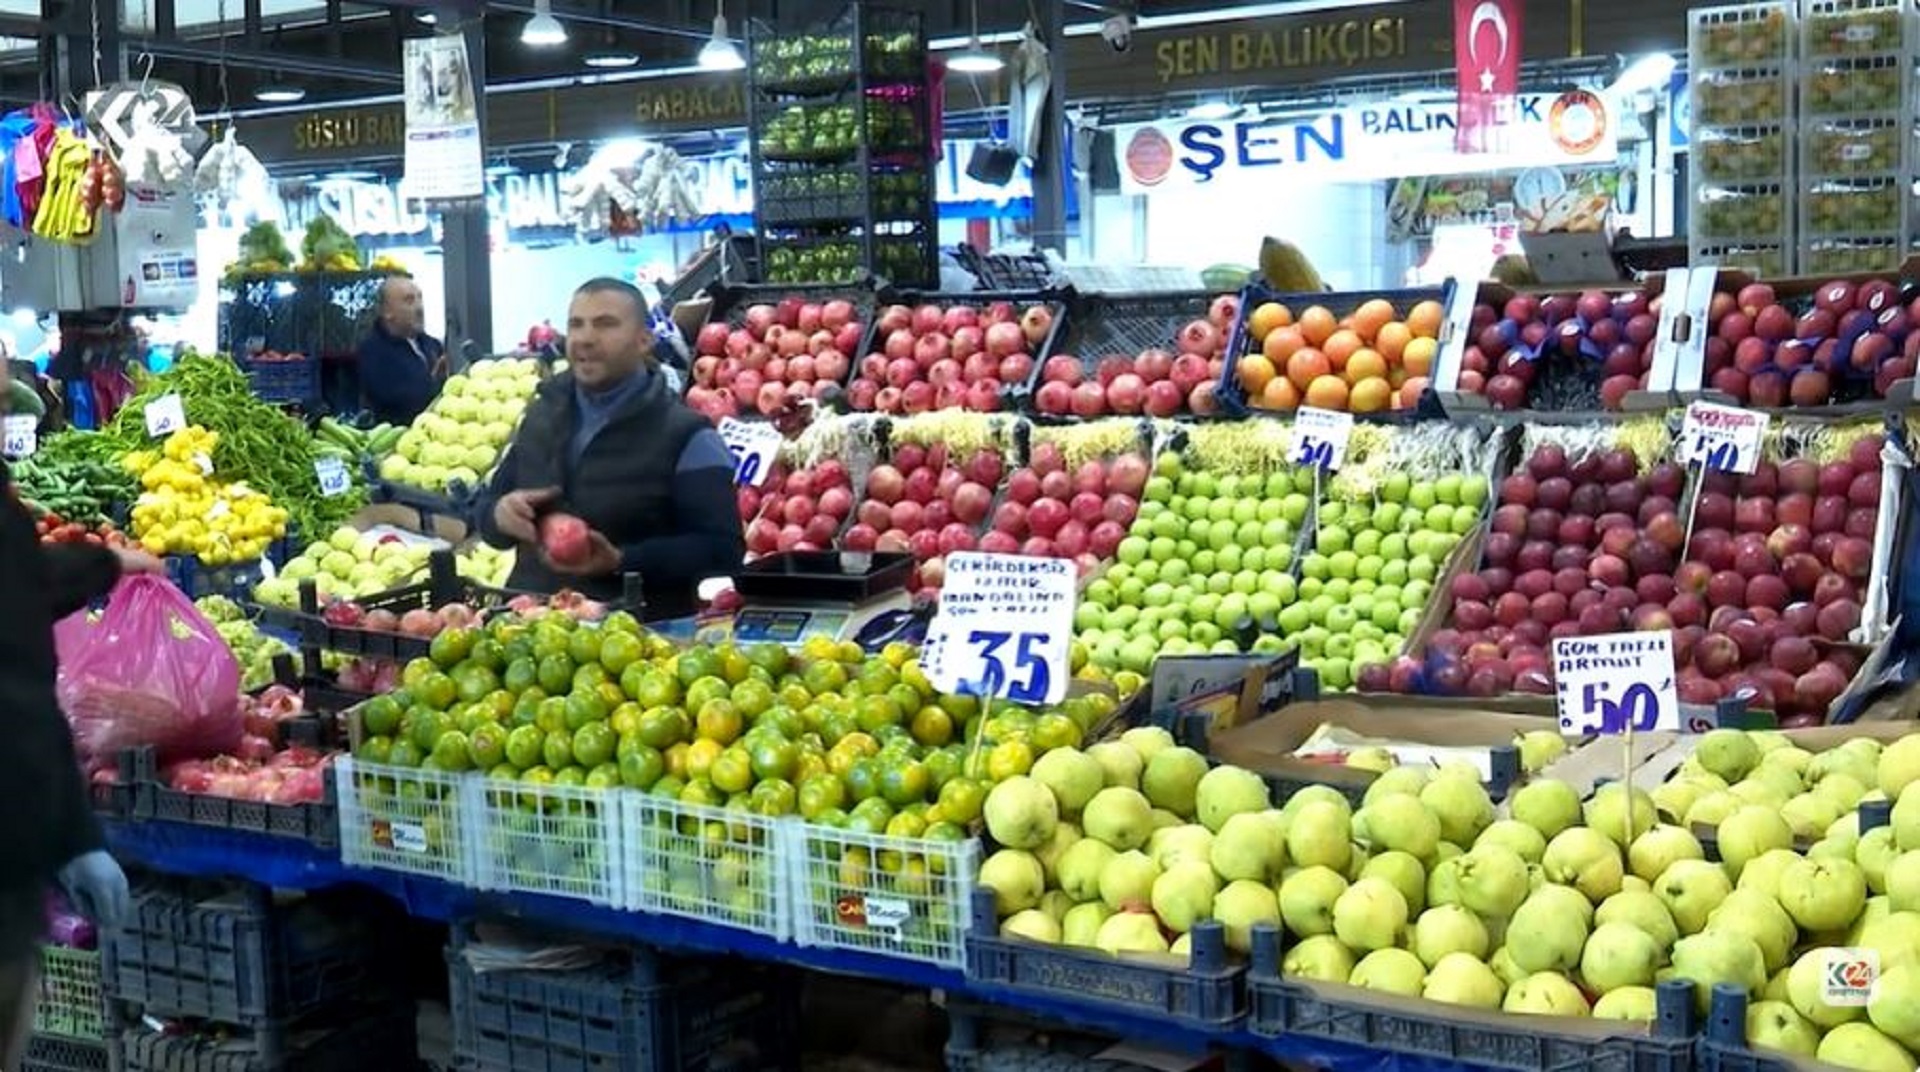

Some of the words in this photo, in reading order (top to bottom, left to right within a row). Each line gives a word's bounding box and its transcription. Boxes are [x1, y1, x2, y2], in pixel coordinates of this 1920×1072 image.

[1157, 37, 1219, 82] ŞEN
[636, 84, 746, 121] BABACA
[1179, 113, 1344, 183] ŞEN
[956, 630, 1050, 702] 35
[1582, 681, 1660, 735] 50
